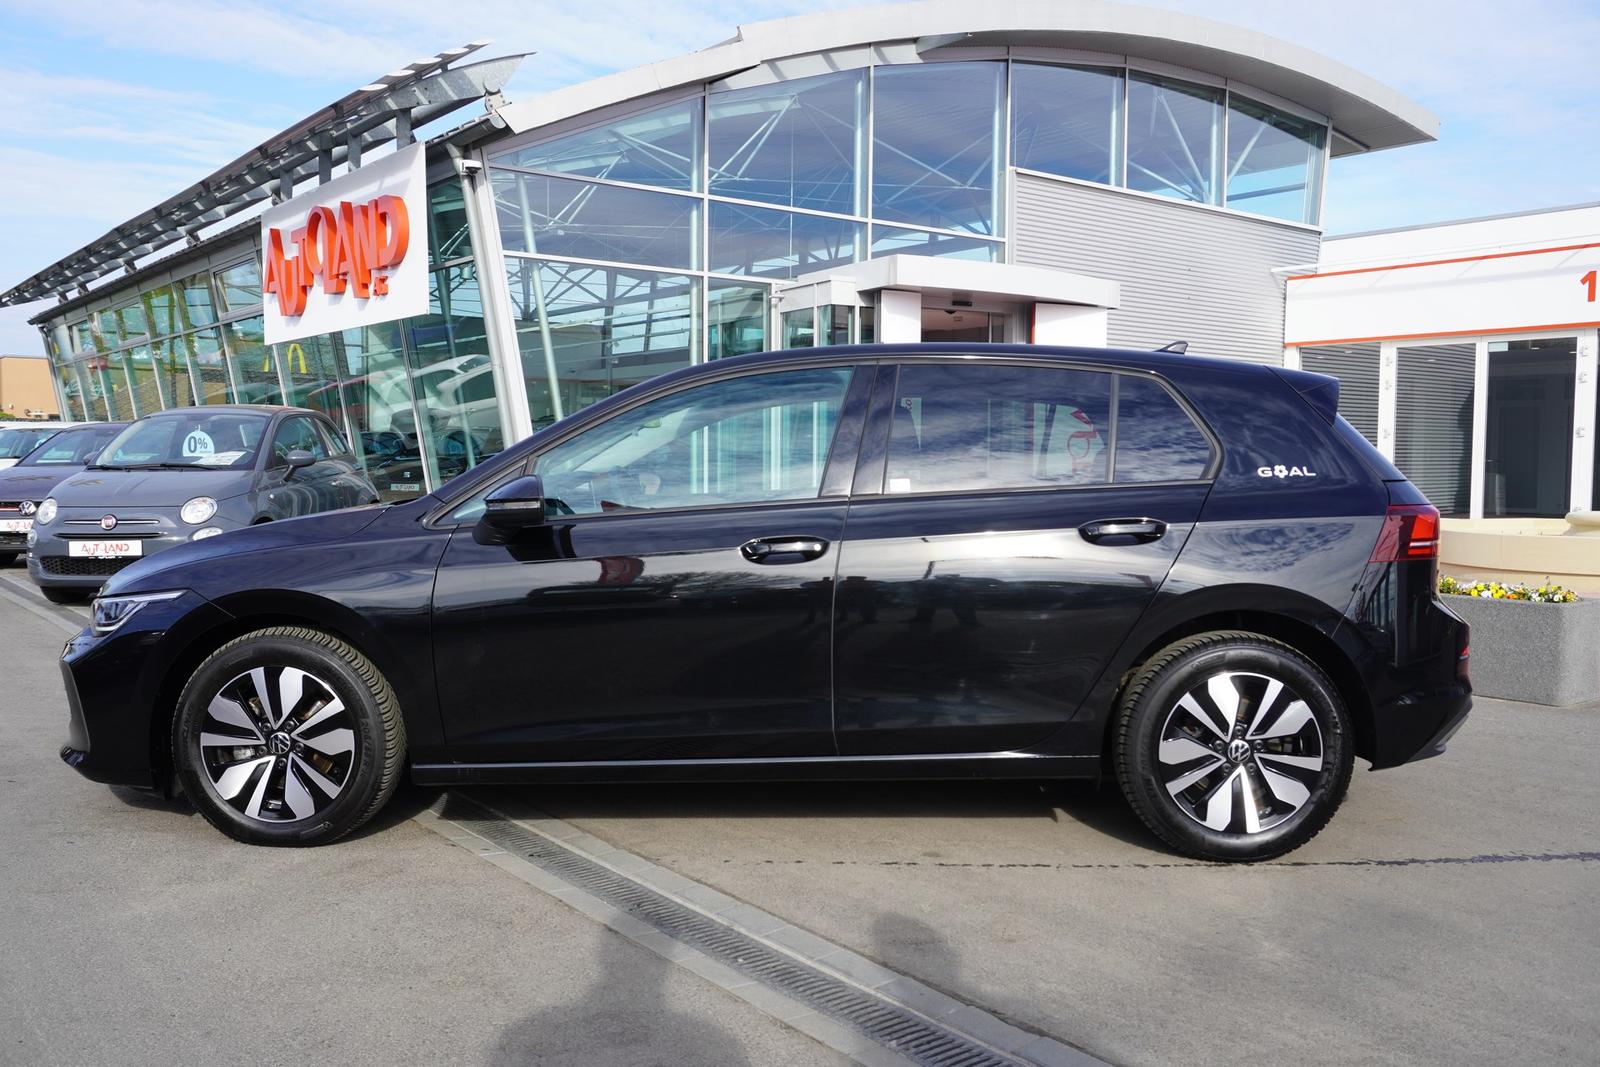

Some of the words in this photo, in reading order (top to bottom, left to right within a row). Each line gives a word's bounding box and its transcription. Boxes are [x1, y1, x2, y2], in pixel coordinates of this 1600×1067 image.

[263, 195, 410, 316] AUTOLAND
[1580, 270, 1597, 302] 1
[81, 543, 130, 555] AUTLAND
